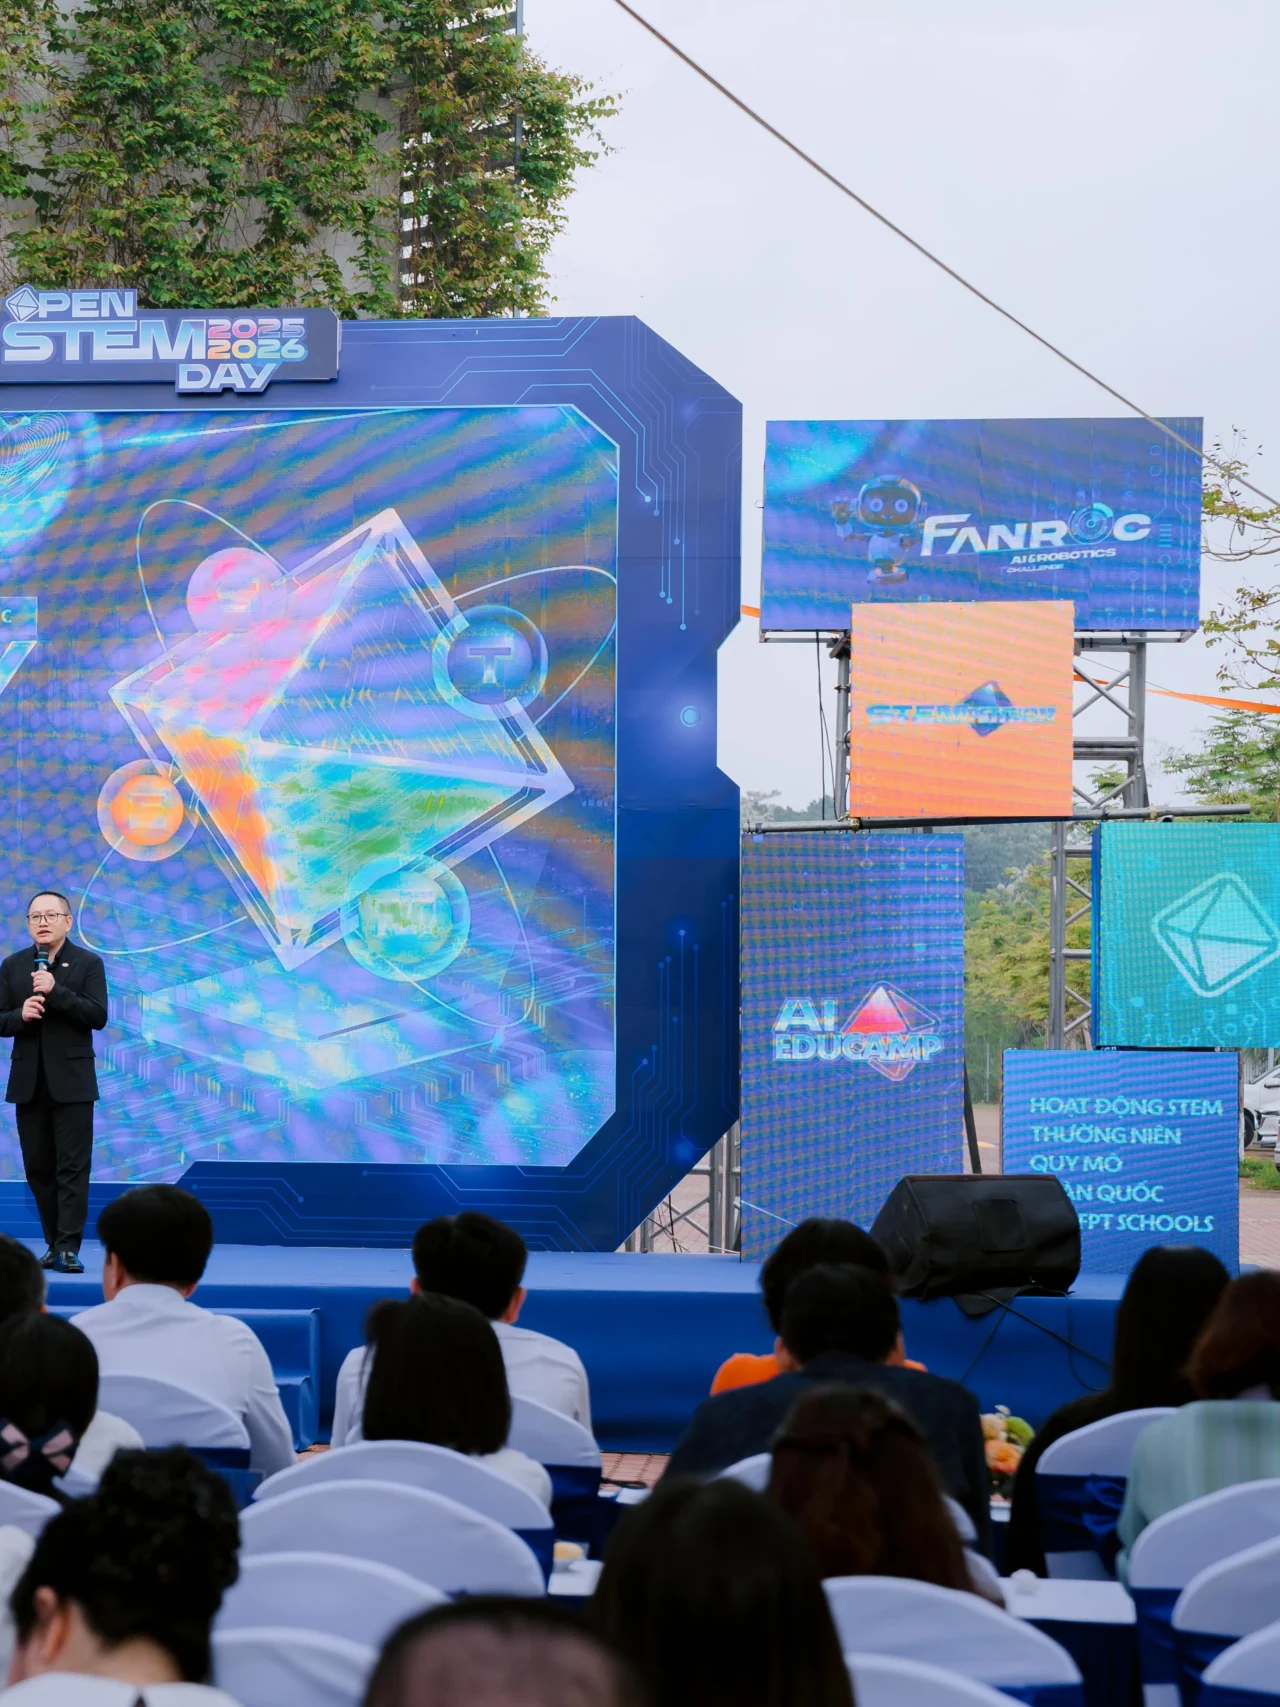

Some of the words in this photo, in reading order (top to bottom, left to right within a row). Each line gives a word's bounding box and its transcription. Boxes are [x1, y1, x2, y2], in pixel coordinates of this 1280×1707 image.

[207, 318, 305, 338] 2025
[2, 319, 207, 361] STEM
[207, 339, 306, 360] 2026
[178, 363, 277, 390] DAY
[773, 997, 838, 1032] AI
[773, 1032, 944, 1062] EDUCAMP
[1029, 1096, 1091, 1118] HOẠT
[1094, 1095, 1164, 1118] ĐỘNG
[1167, 1098, 1224, 1116] STEM
[1030, 1123, 1127, 1143] THƯỜNG
[1130, 1124, 1182, 1144] NIÊN
[1028, 1154, 1080, 1173] QUY
[1082, 1152, 1124, 1173] MÔ
[1096, 1180, 1165, 1204] QUỐC
[1078, 1213, 1114, 1230] FPT
[1116, 1213, 1215, 1232] SCHOOLS
